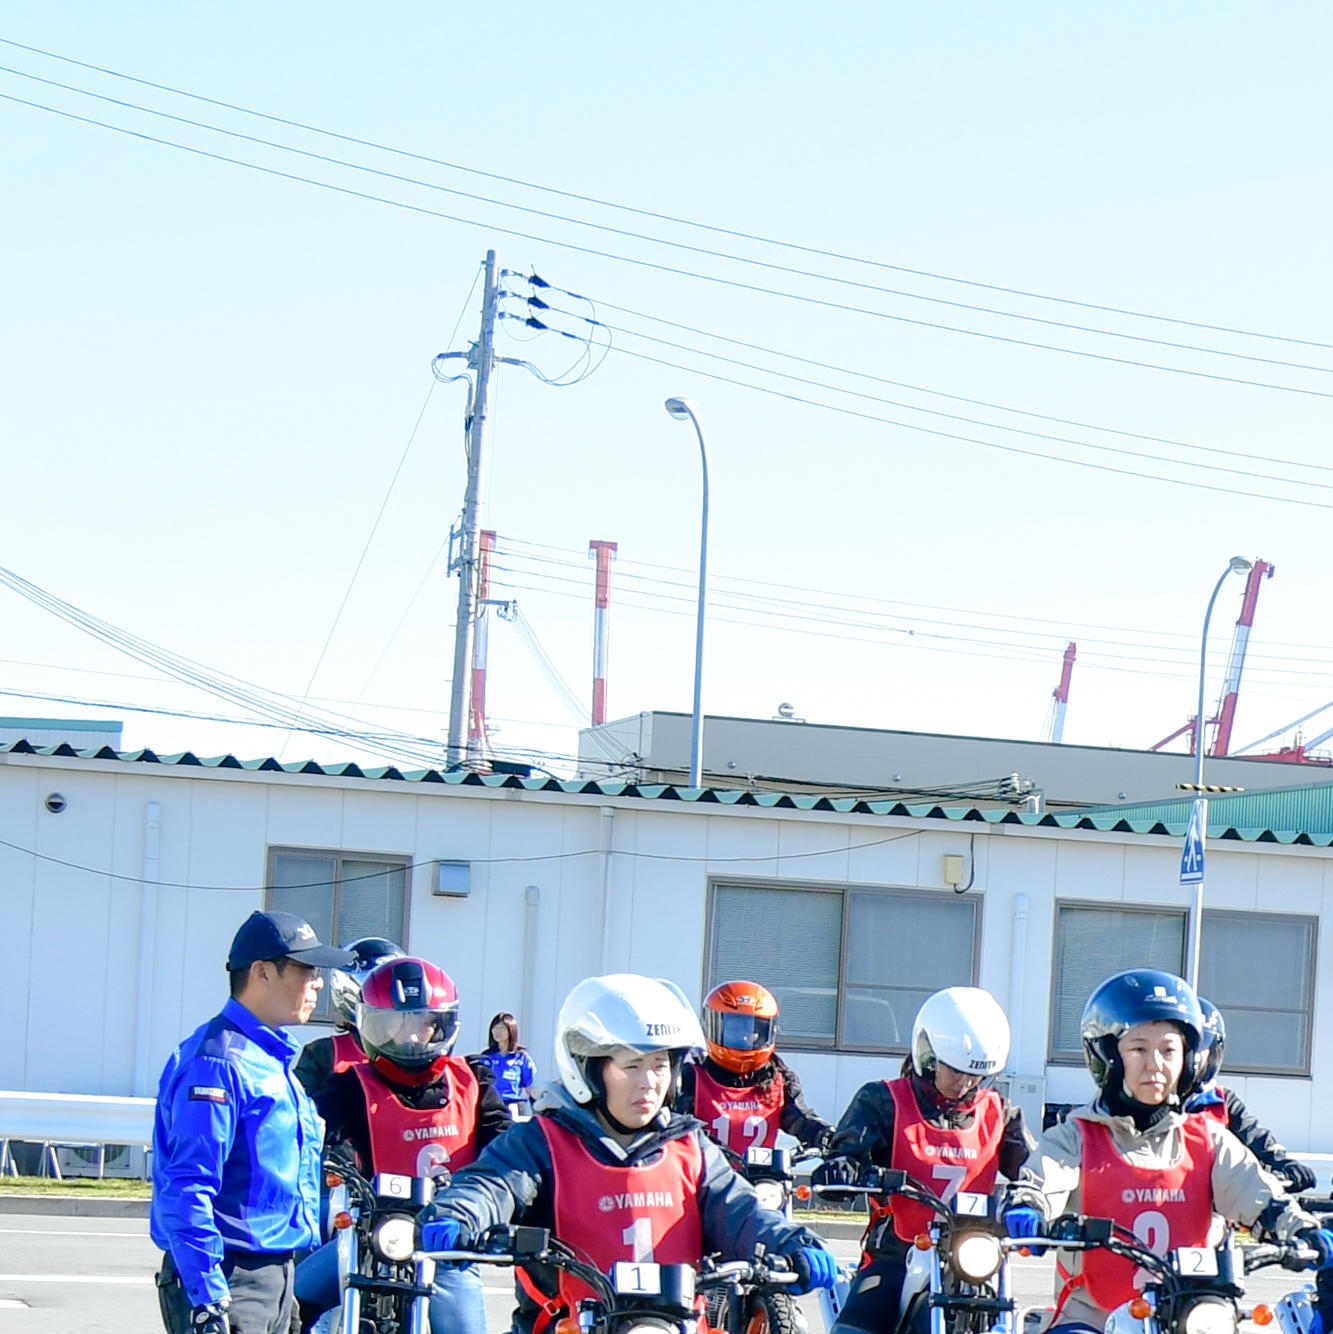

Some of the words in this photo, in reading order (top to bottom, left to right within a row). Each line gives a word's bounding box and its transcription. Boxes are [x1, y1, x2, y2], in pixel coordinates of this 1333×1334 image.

[727, 1101, 761, 1111] YAMAHA
[414, 1124, 459, 1140] YAMAHA
[750, 1149, 771, 1164] 12
[936, 1145, 978, 1160] YAMAHA
[416, 1143, 452, 1188] 6
[390, 1176, 402, 1195] 6
[932, 1164, 967, 1221] 7
[614, 1191, 674, 1210] YAMAHA
[966, 1195, 978, 1213] 7
[1136, 1188, 1187, 1203] YAMAHA
[622, 1217, 654, 1263] 1
[1191, 1251, 1205, 1272] 2
[631, 1266, 647, 1291] 1
